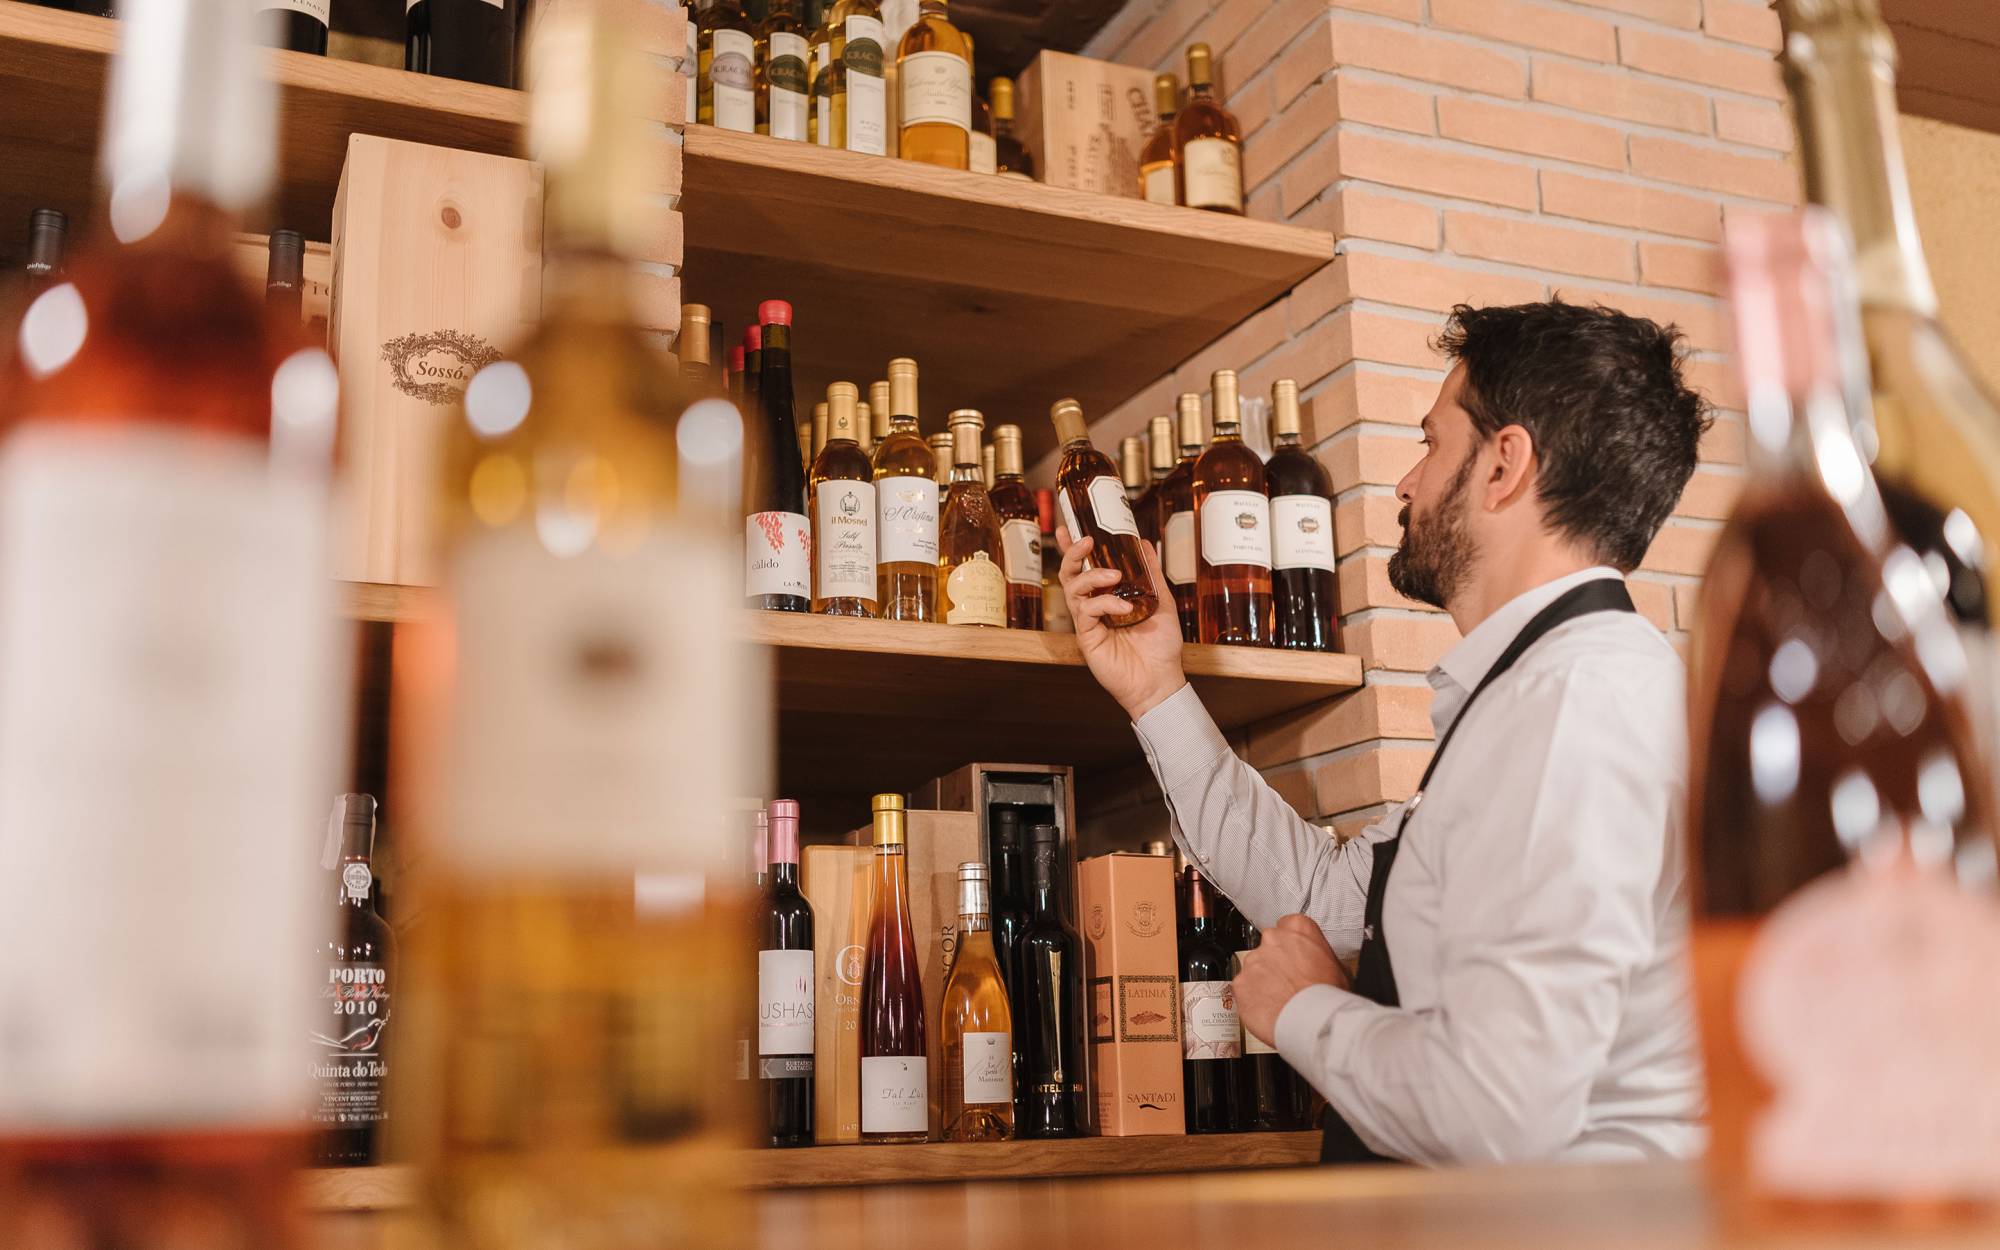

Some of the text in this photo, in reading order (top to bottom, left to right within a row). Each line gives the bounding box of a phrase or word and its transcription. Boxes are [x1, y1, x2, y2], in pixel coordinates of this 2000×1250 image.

[416, 361, 464, 380] Sossó
[329, 968, 385, 984] PORTO
[1128, 989, 1166, 998] LATINIA
[333, 1000, 377, 1015] 2010
[761, 1002, 812, 1020] USHAS
[308, 1061, 388, 1079] Quinta do Tedo
[1127, 1093, 1176, 1103] SANTADI
